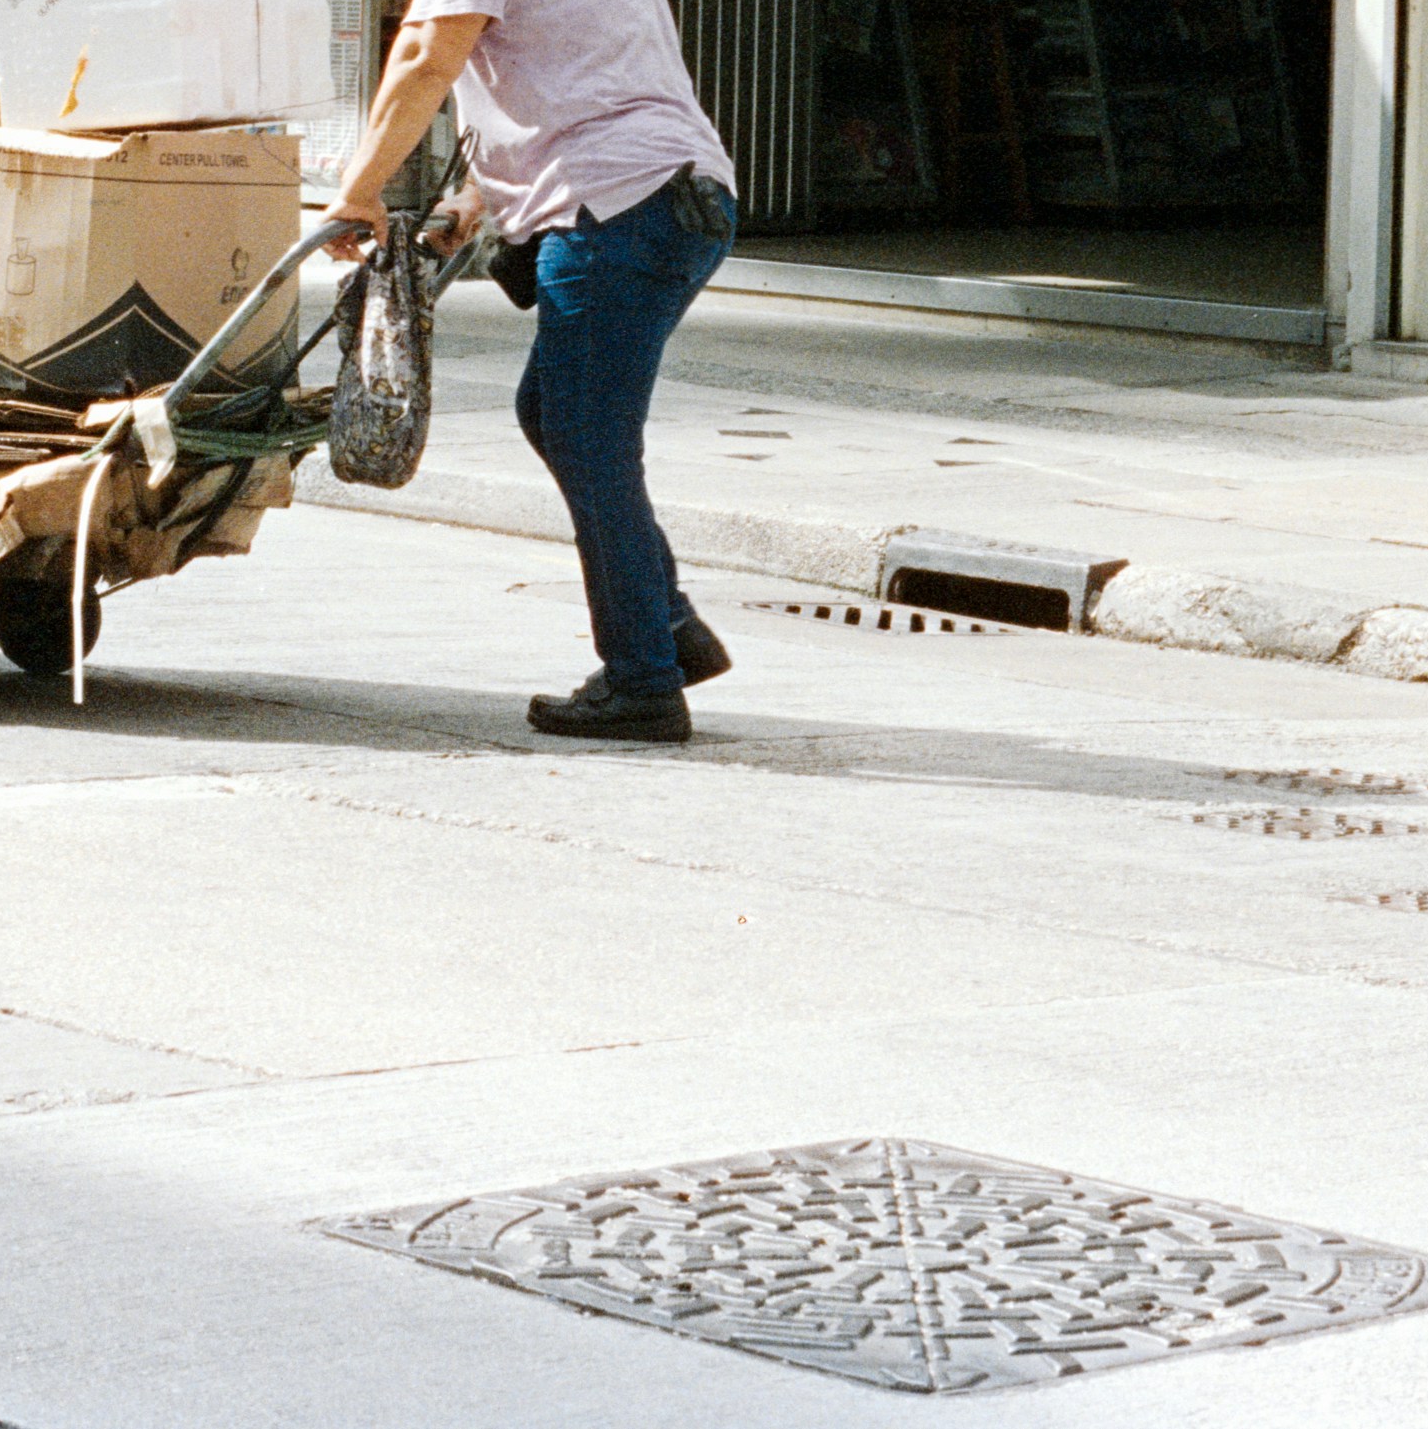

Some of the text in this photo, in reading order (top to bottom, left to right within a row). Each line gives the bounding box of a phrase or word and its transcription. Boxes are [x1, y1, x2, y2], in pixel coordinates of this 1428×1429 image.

[159, 153, 196, 167] CENTER
[196, 154, 221, 167] PULL
[221, 154, 251, 169] TOWEL
